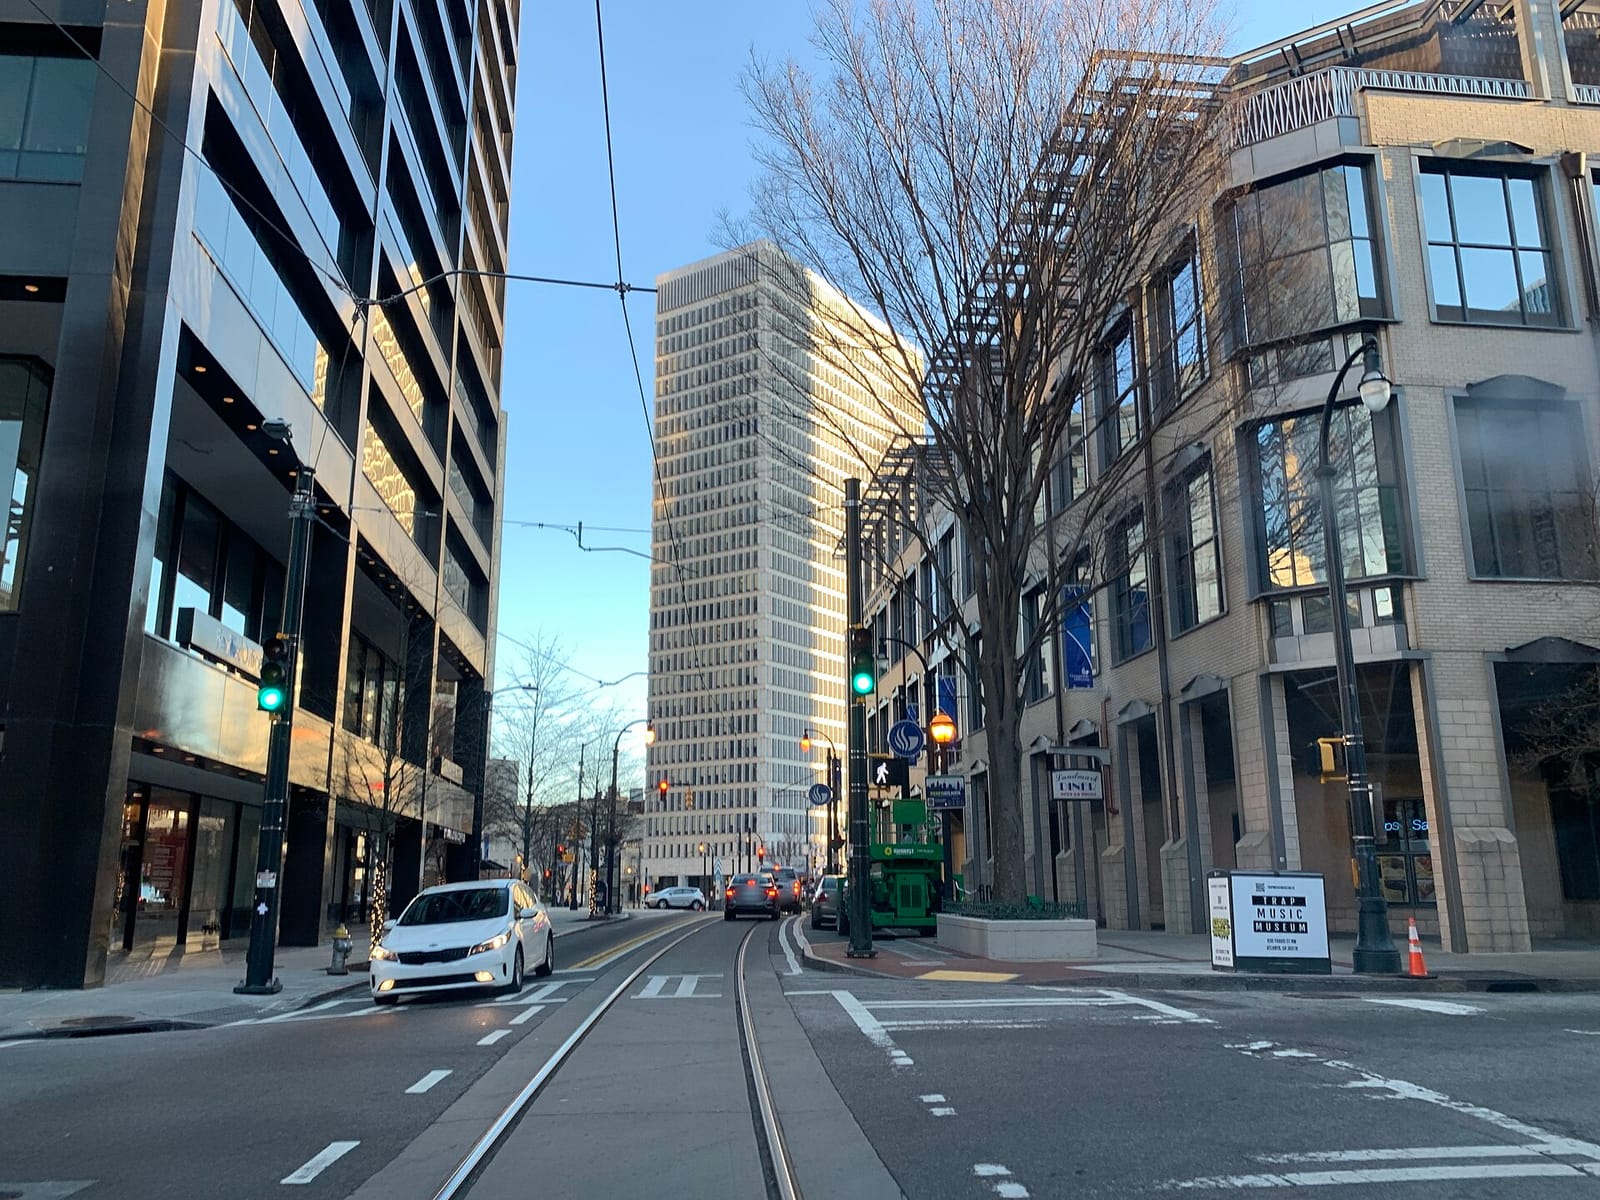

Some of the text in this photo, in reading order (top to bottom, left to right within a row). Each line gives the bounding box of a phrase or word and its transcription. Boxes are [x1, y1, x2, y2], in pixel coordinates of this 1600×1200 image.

[1263, 896, 1296, 905] TRAP
[1256, 908, 1303, 919] MUSIC
[1255, 922, 1306, 933] MUSEUM
